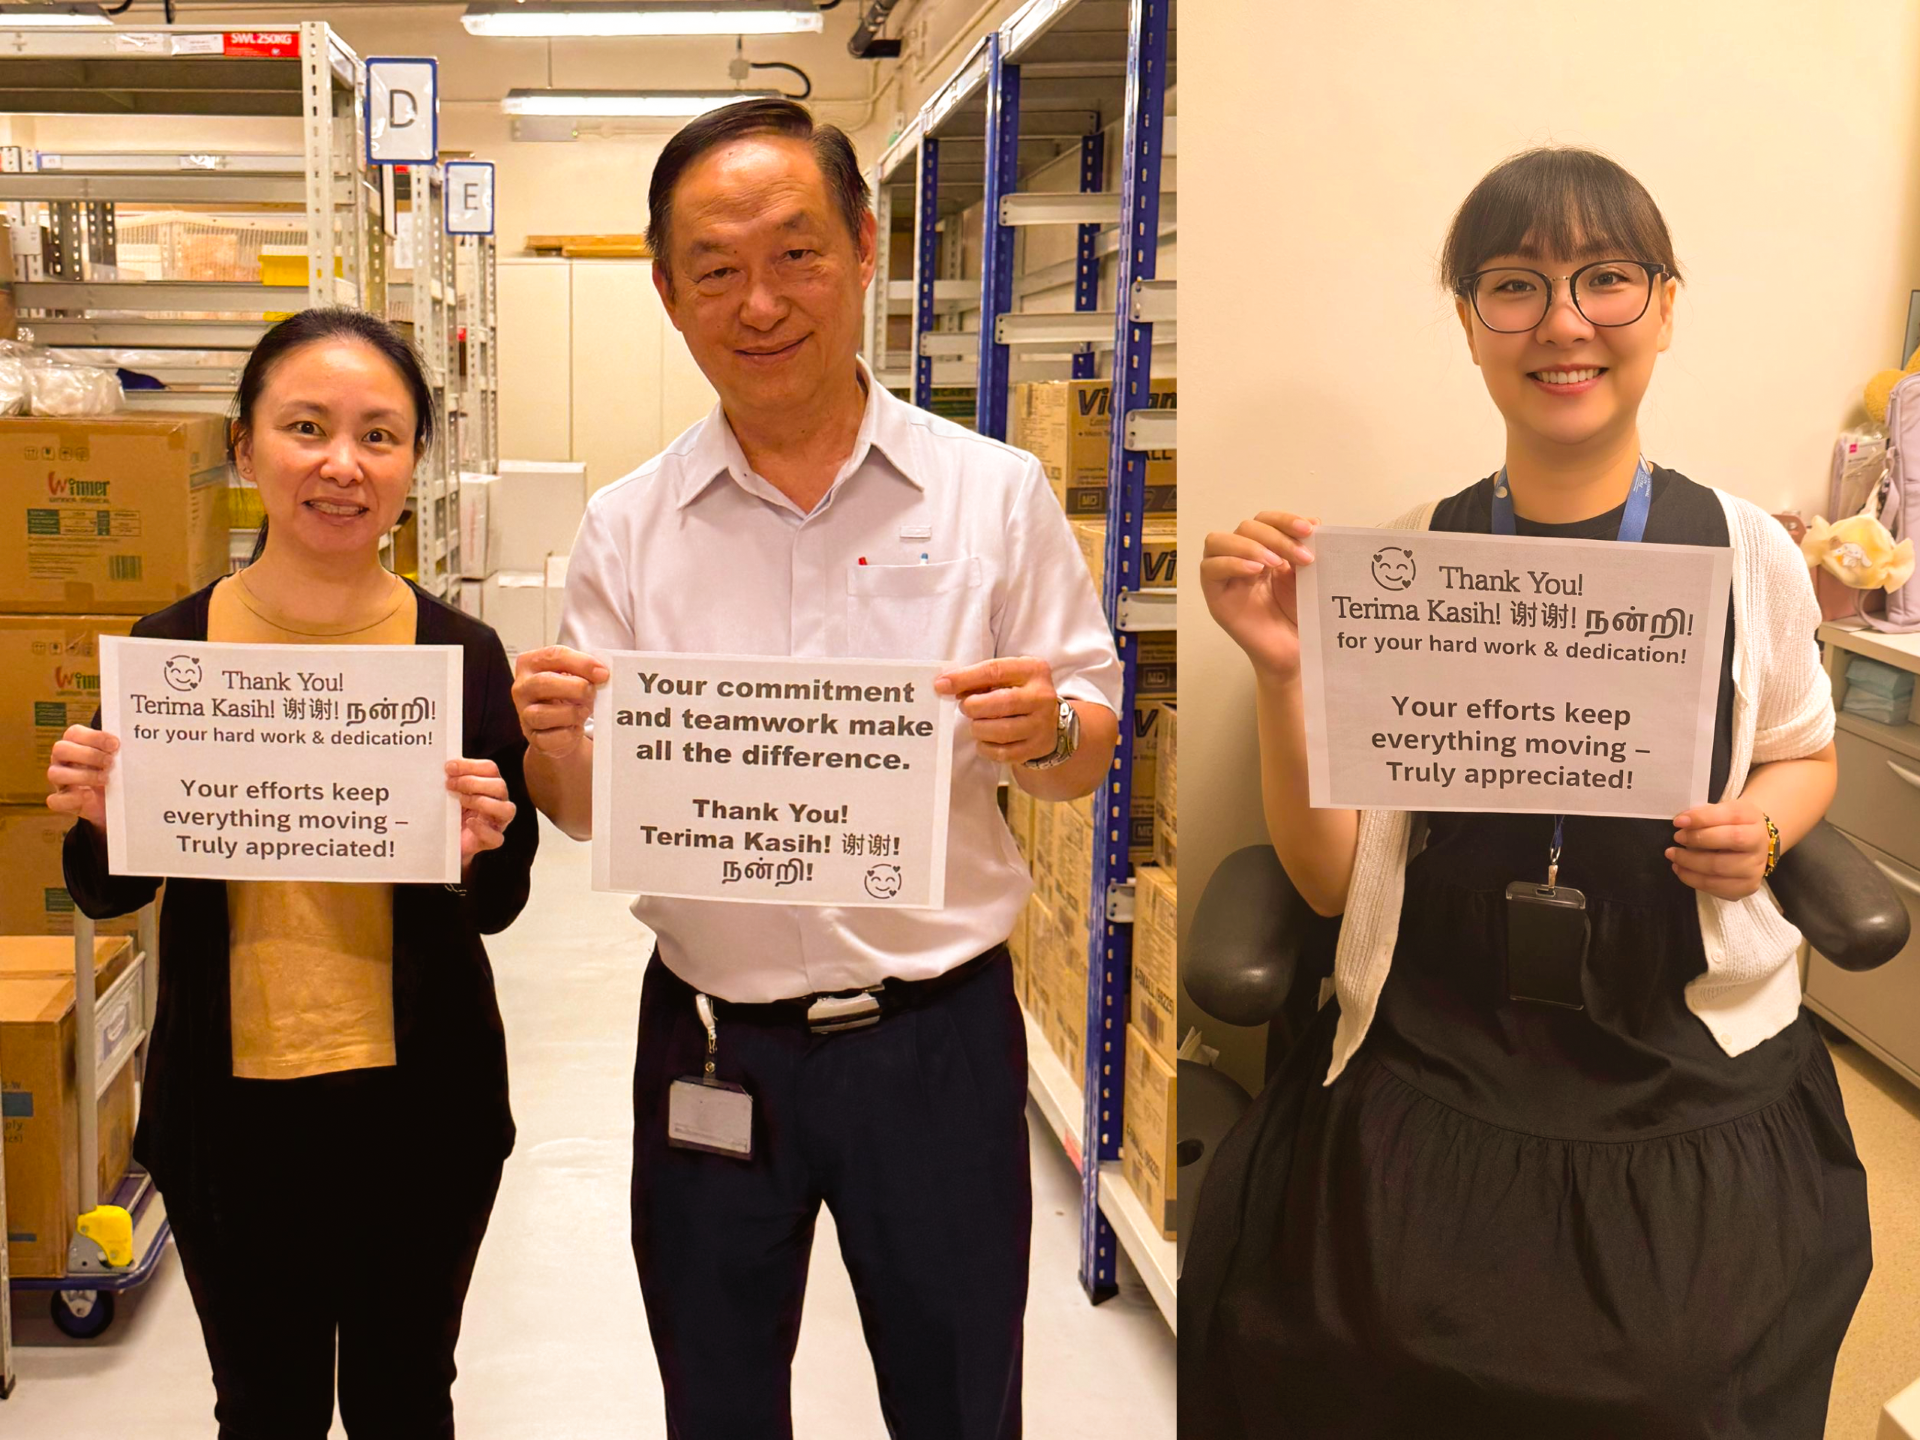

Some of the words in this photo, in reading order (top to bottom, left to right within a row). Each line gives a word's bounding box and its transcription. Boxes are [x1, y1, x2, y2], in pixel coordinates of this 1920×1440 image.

[231, 33, 256, 44] SWL
[389, 89, 418, 128] D
[464, 183, 479, 211] E
[1439, 566, 1520, 592] Thank
[1527, 571, 1582, 596] You!
[1332, 596, 1420, 621] Terima
[1427, 599, 1500, 625] Kasih!
[1337, 632, 1367, 648] for
[1374, 637, 1422, 653] your
[1430, 635, 1476, 653] hard
[1484, 640, 1536, 655] work
[1544, 642, 1558, 657] &
[1566, 643, 1686, 664] dedication!
[222, 671, 291, 691] Thank
[297, 673, 343, 691] You!
[638, 673, 707, 695] Your
[717, 679, 914, 702] commitment
[131, 694, 205, 716] Terima
[212, 698, 274, 718] Kasih!
[1391, 696, 1457, 717] Your
[1467, 699, 1555, 721] efforts
[1566, 702, 1630, 729] keep
[134, 725, 159, 739] for
[166, 730, 207, 743] your
[214, 727, 254, 742] hard
[261, 730, 306, 744] work
[312, 731, 324, 744] &
[331, 731, 432, 745] dedication!
[617, 707, 671, 727] and
[682, 709, 838, 734] teamwork
[850, 715, 933, 736] make
[637, 740, 671, 760] all
[683, 742, 731, 763] the
[742, 745, 909, 769] difference.
[1372, 730, 1516, 757] everything
[1526, 735, 1626, 763] moving
[1386, 762, 1456, 787] Truly
[1465, 766, 1632, 789] appreciated!
[181, 780, 238, 798] Your
[246, 781, 324, 800] efforts
[333, 783, 389, 805] keep
[164, 809, 291, 832] everything
[299, 811, 387, 834] moving
[693, 799, 778, 821] Thank
[789, 804, 847, 823] You!
[176, 835, 237, 858] Truly
[246, 839, 394, 860] appreciated!
[640, 826, 733, 849] Terima
[745, 832, 830, 853] Kasih!
